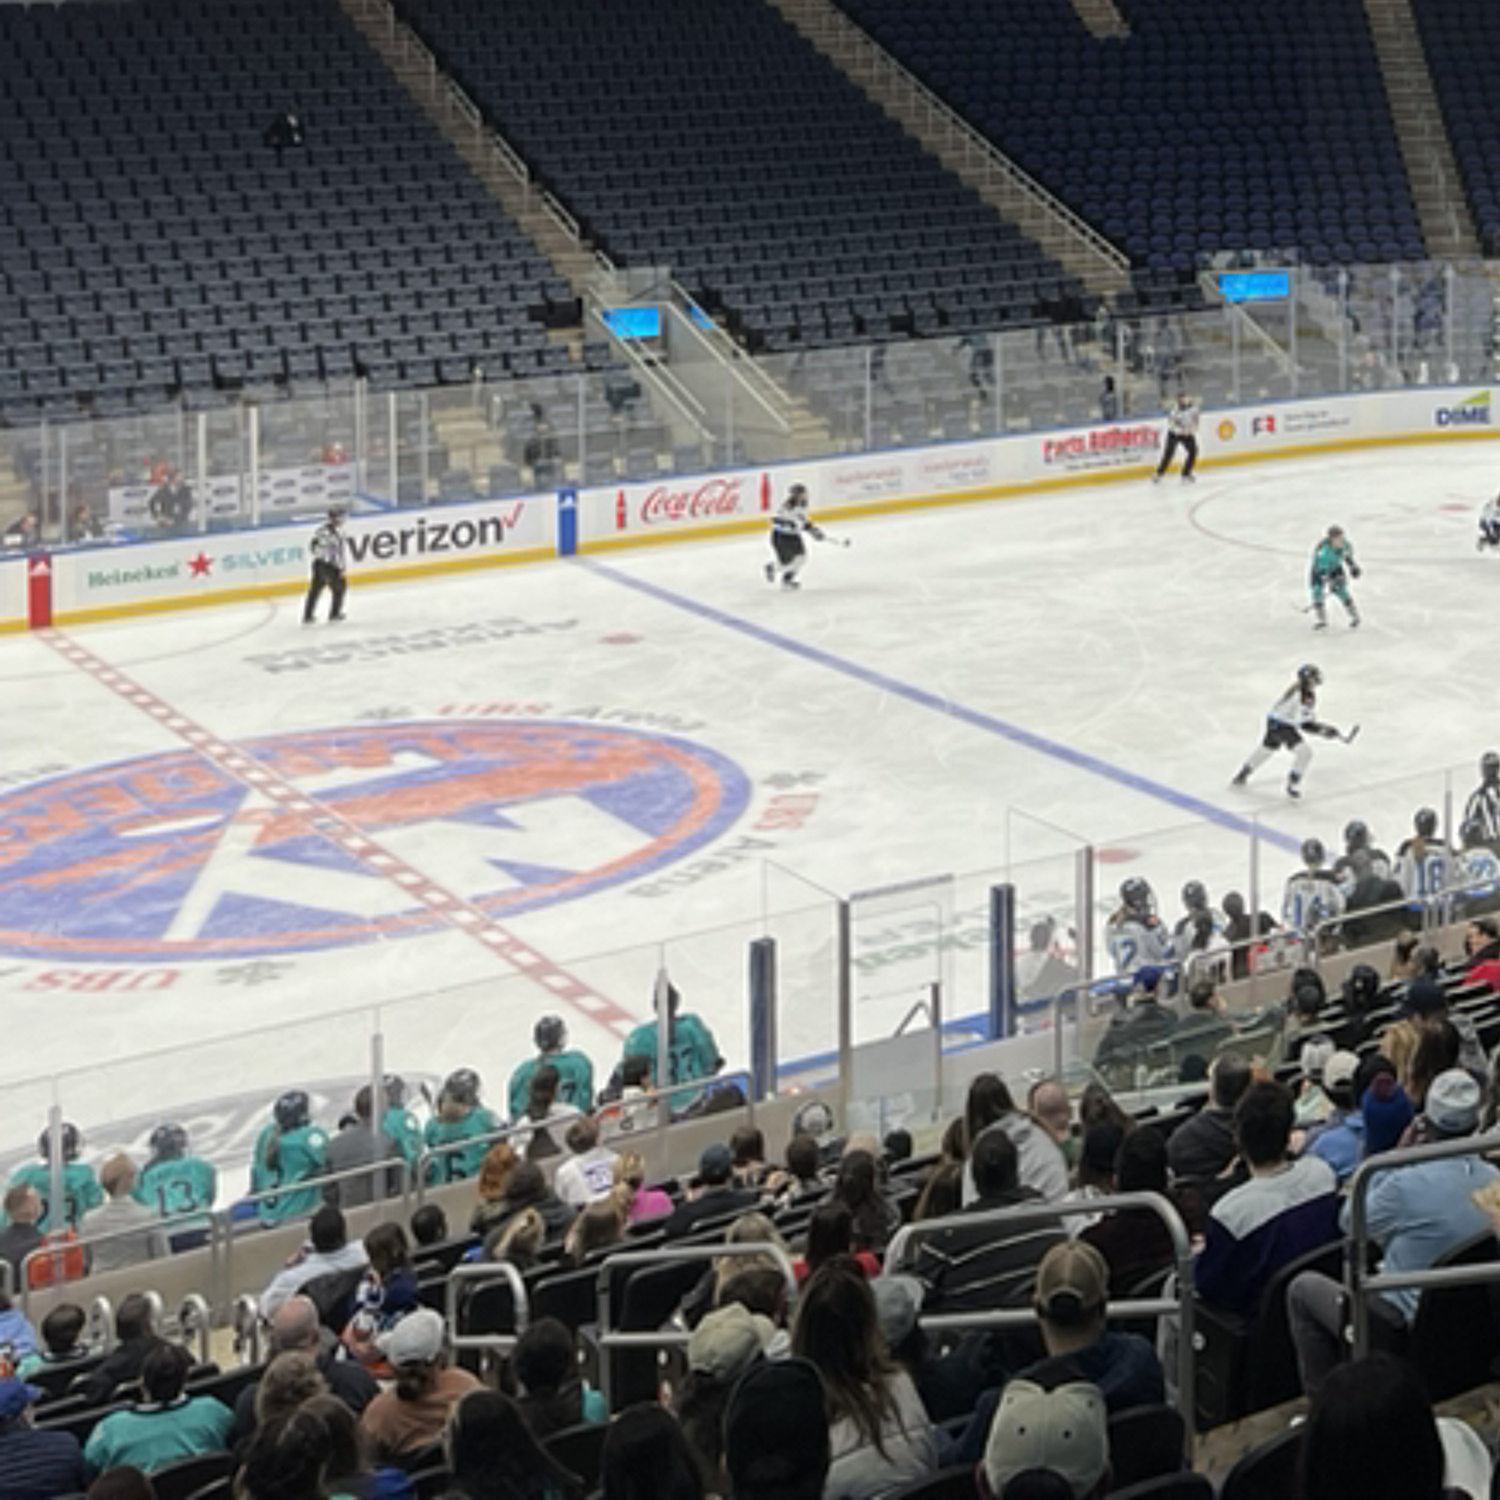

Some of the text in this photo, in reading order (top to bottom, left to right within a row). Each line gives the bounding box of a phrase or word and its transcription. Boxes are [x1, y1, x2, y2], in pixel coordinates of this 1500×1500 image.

[345, 513, 506, 564] verizon
[87, 546, 305, 589] Heineken SILVER
